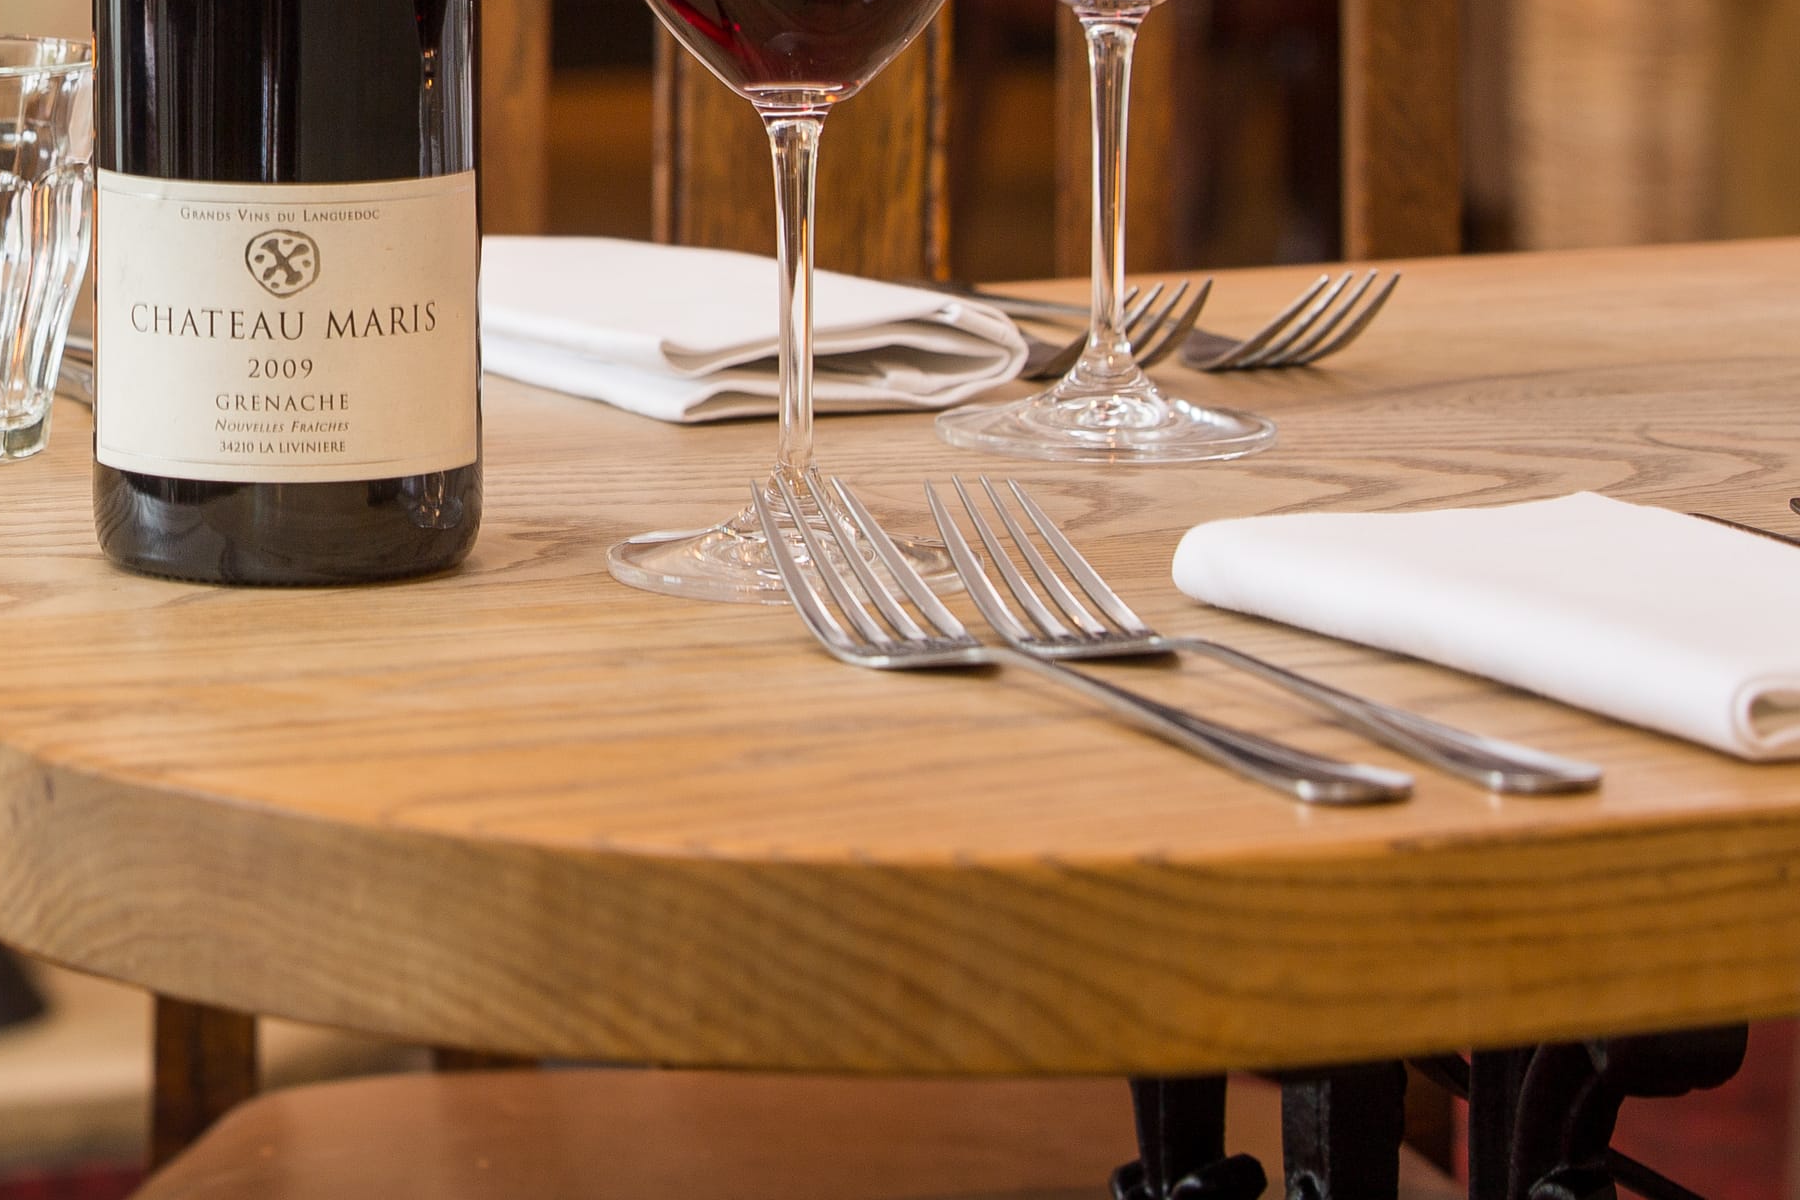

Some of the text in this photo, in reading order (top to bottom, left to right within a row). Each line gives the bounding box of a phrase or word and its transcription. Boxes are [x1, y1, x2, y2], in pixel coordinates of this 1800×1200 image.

[181, 207, 379, 223] GRANDS VINS DU LANGUEDOC
[131, 300, 435, 340] CHATEAU MARIS
[248, 358, 313, 379] 2009
[216, 393, 349, 413] GRENACHE
[215, 417, 284, 433] NOUVELLES
[220, 440, 345, 453] 34210 LA LIVINIERE
